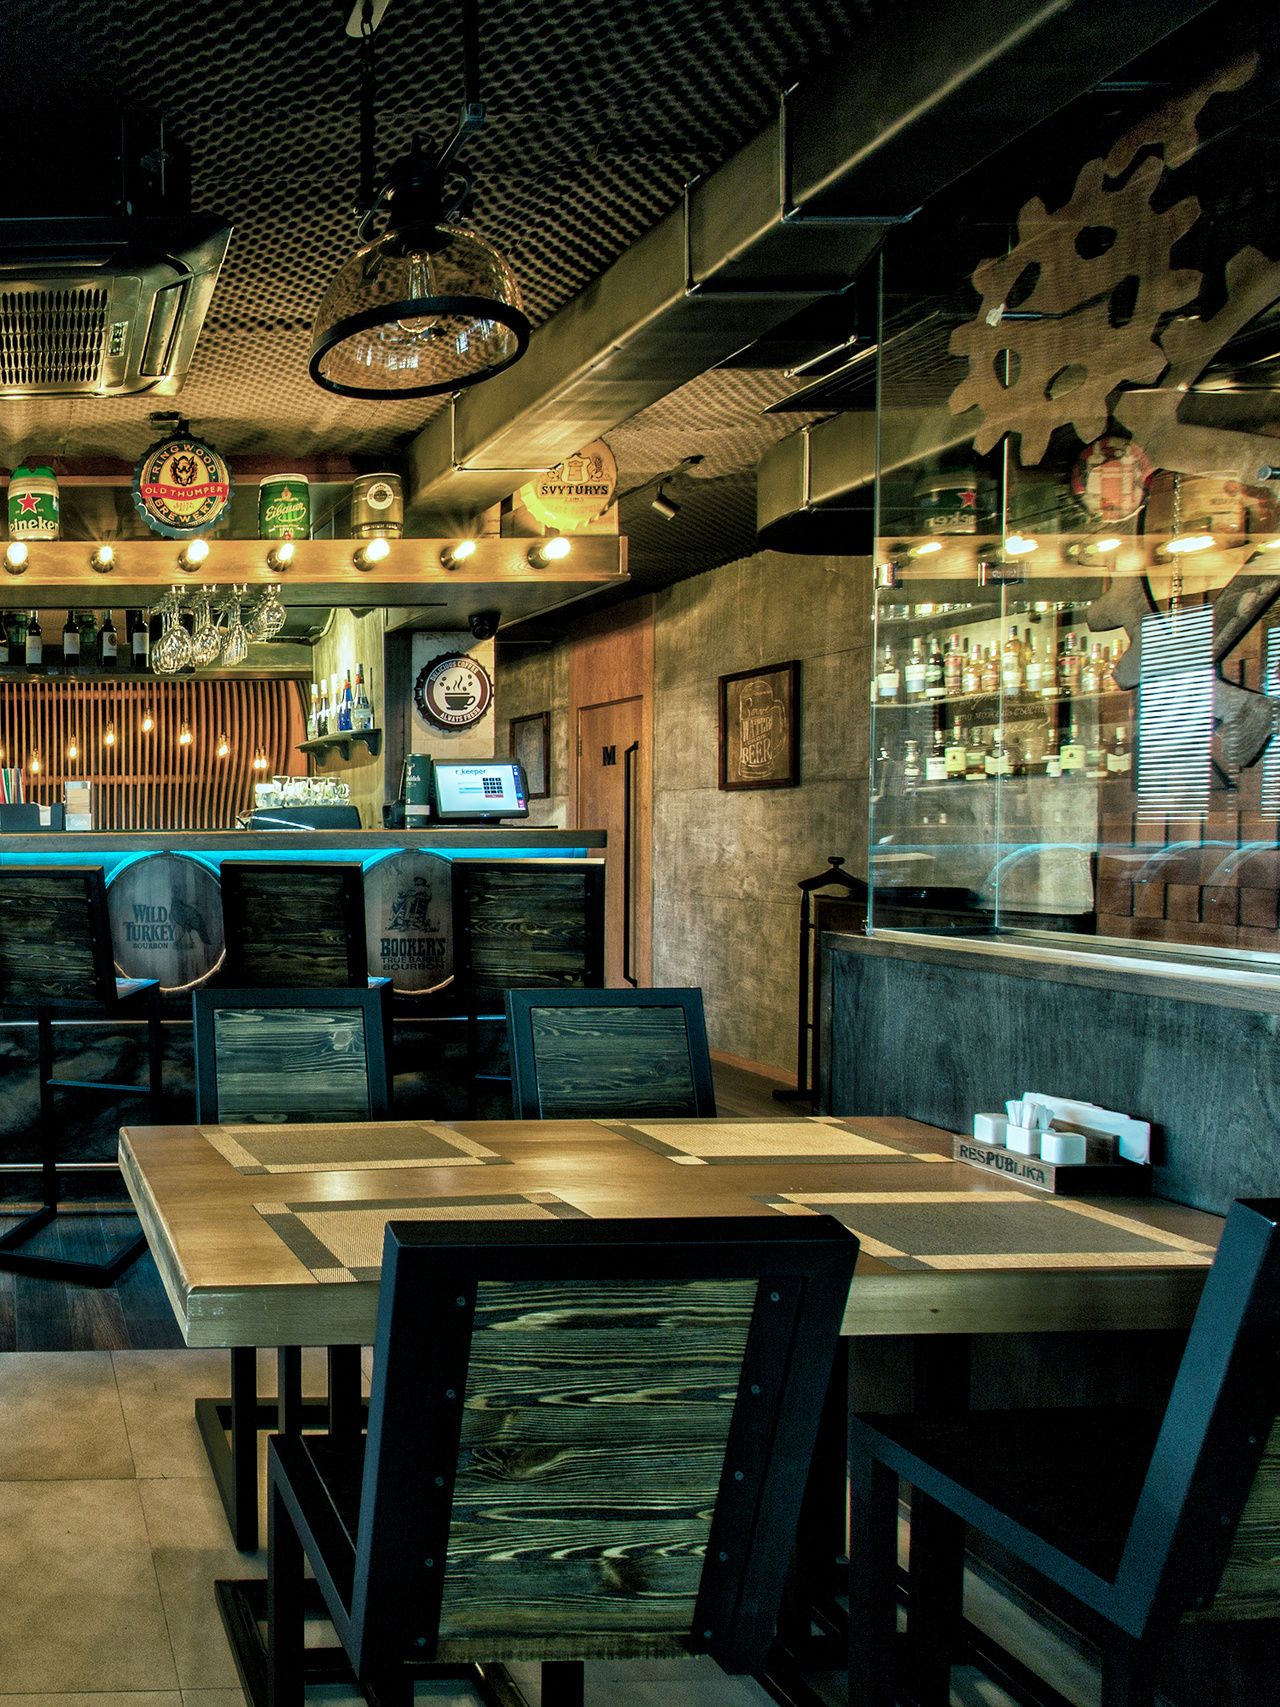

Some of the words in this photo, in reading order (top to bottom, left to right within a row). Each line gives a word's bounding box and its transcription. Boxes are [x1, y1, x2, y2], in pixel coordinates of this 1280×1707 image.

[152, 443, 216, 474] RINGWOOD
[144, 486, 167, 494] OLD
[170, 486, 223, 498] THUMPER
[154, 498, 214, 523] BREWERY
[430, 661, 456, 682] DELICIOUS
[458, 661, 480, 674] COFFEE
[440, 712, 464, 722] ALWAYS
[464, 706, 481, 720] FRESH
[742, 716, 773, 742] WATER
[602, 745, 616, 766] M
[742, 738, 773, 764] BEER
[132, 904, 168, 924] WILD
[122, 922, 176, 942] TURKEY
[132, 942, 168, 950] BOURBON
[380, 938, 446, 956] BOOKER'S
[382, 956, 406, 964] TRUE
[960, 1144, 1046, 1184] RESPUBLIKA
